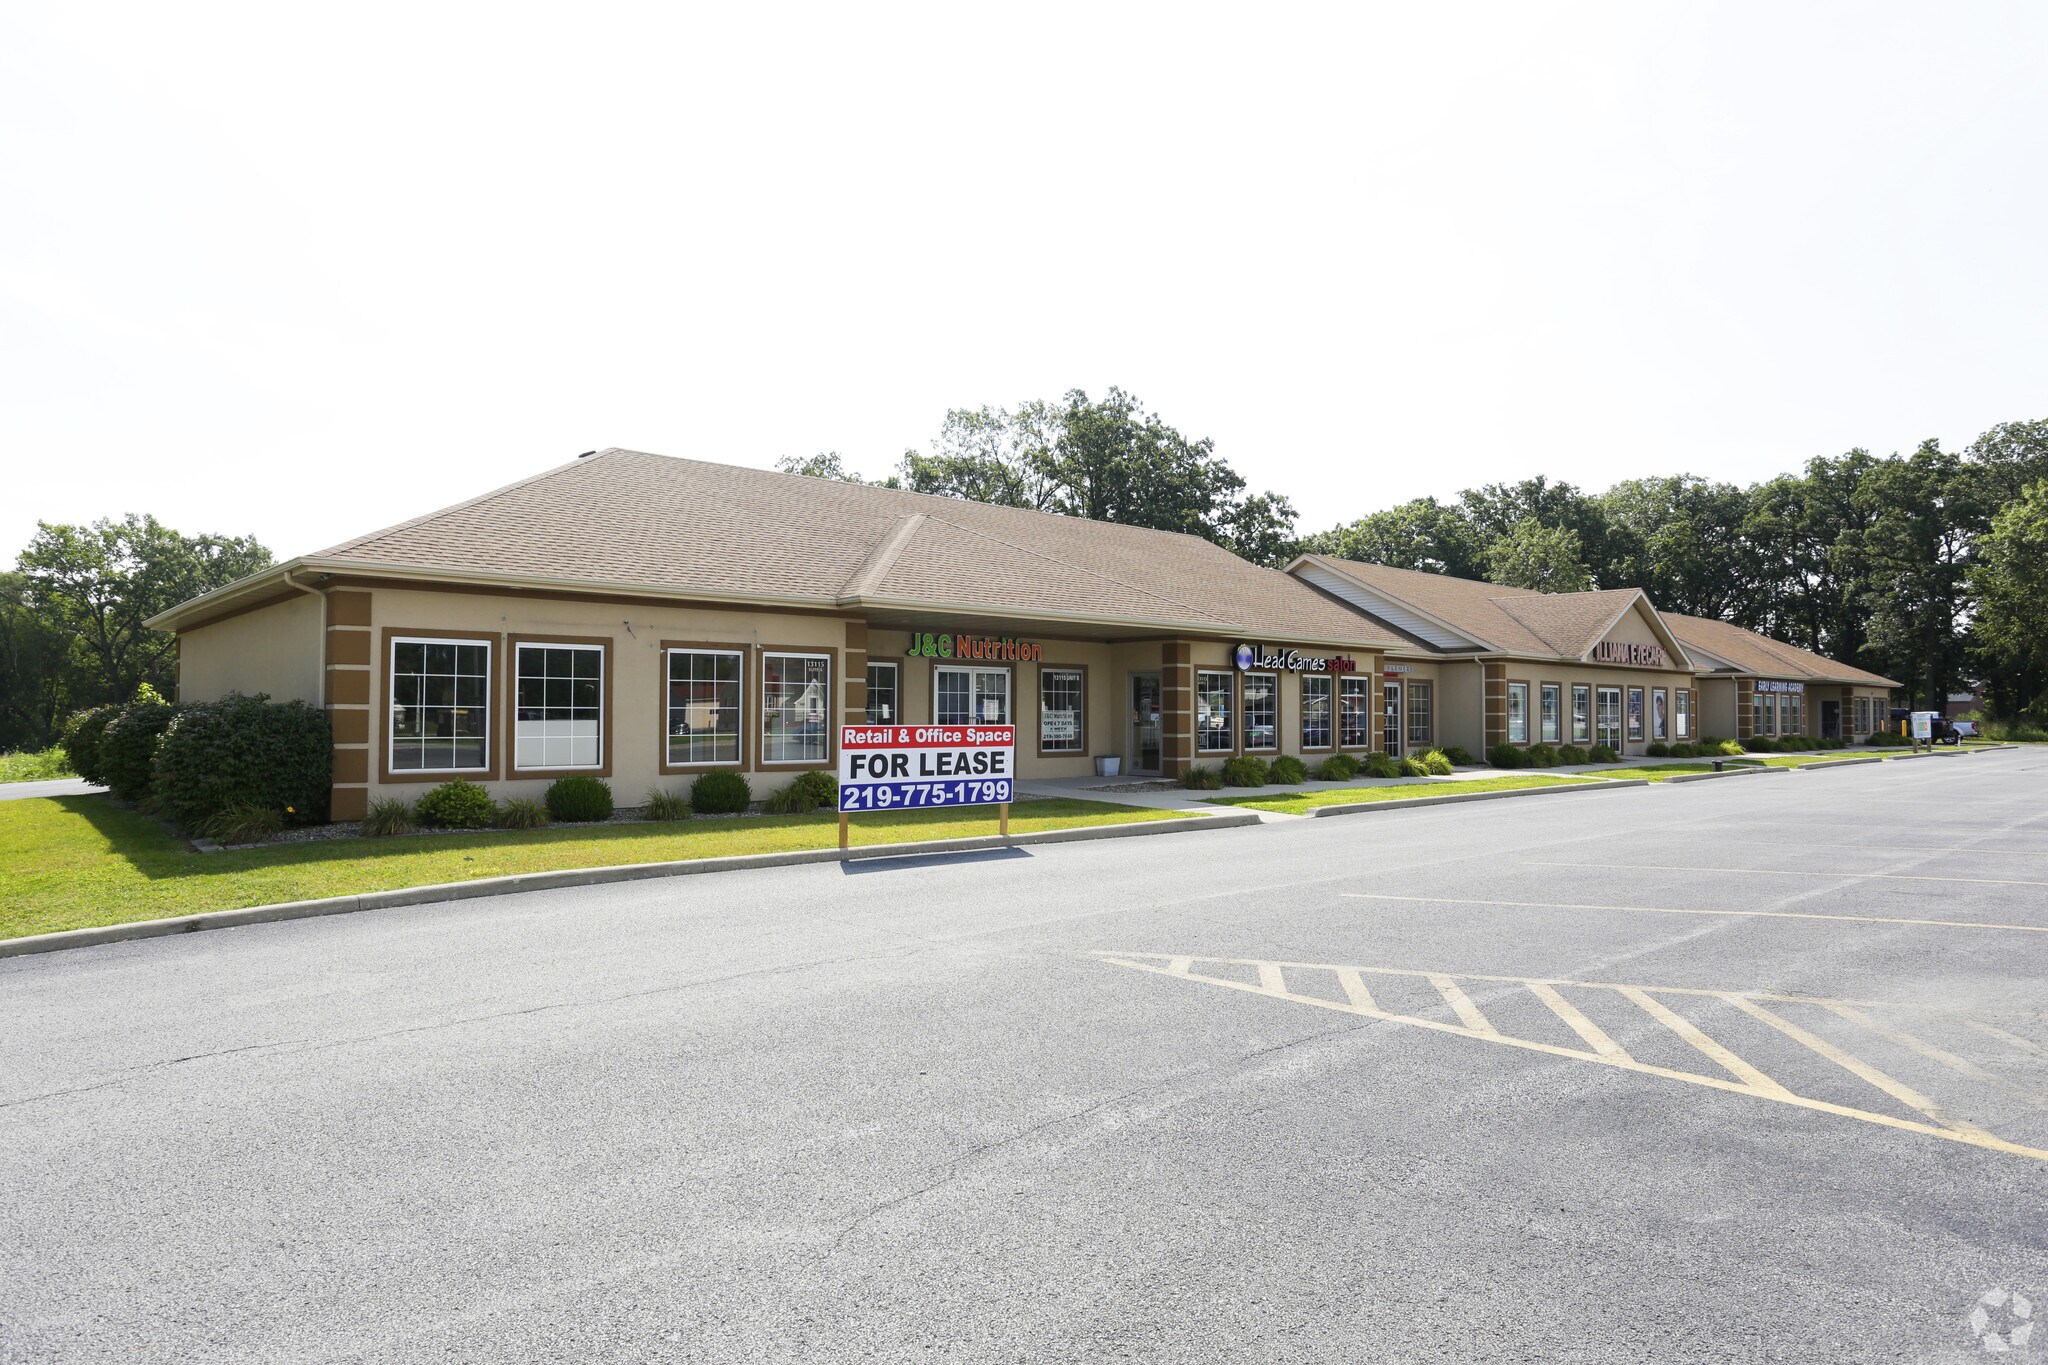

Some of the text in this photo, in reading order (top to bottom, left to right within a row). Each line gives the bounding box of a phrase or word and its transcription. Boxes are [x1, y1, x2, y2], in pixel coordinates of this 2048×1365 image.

[909, 633, 1043, 661] J&C Nutrition
[1253, 645, 1356, 673] Head Games salon
[844, 729, 1012, 745] Retail & Office Space
[850, 751, 1006, 779] FOR LEASE
[844, 780, 1010, 809] 219-775-1799
